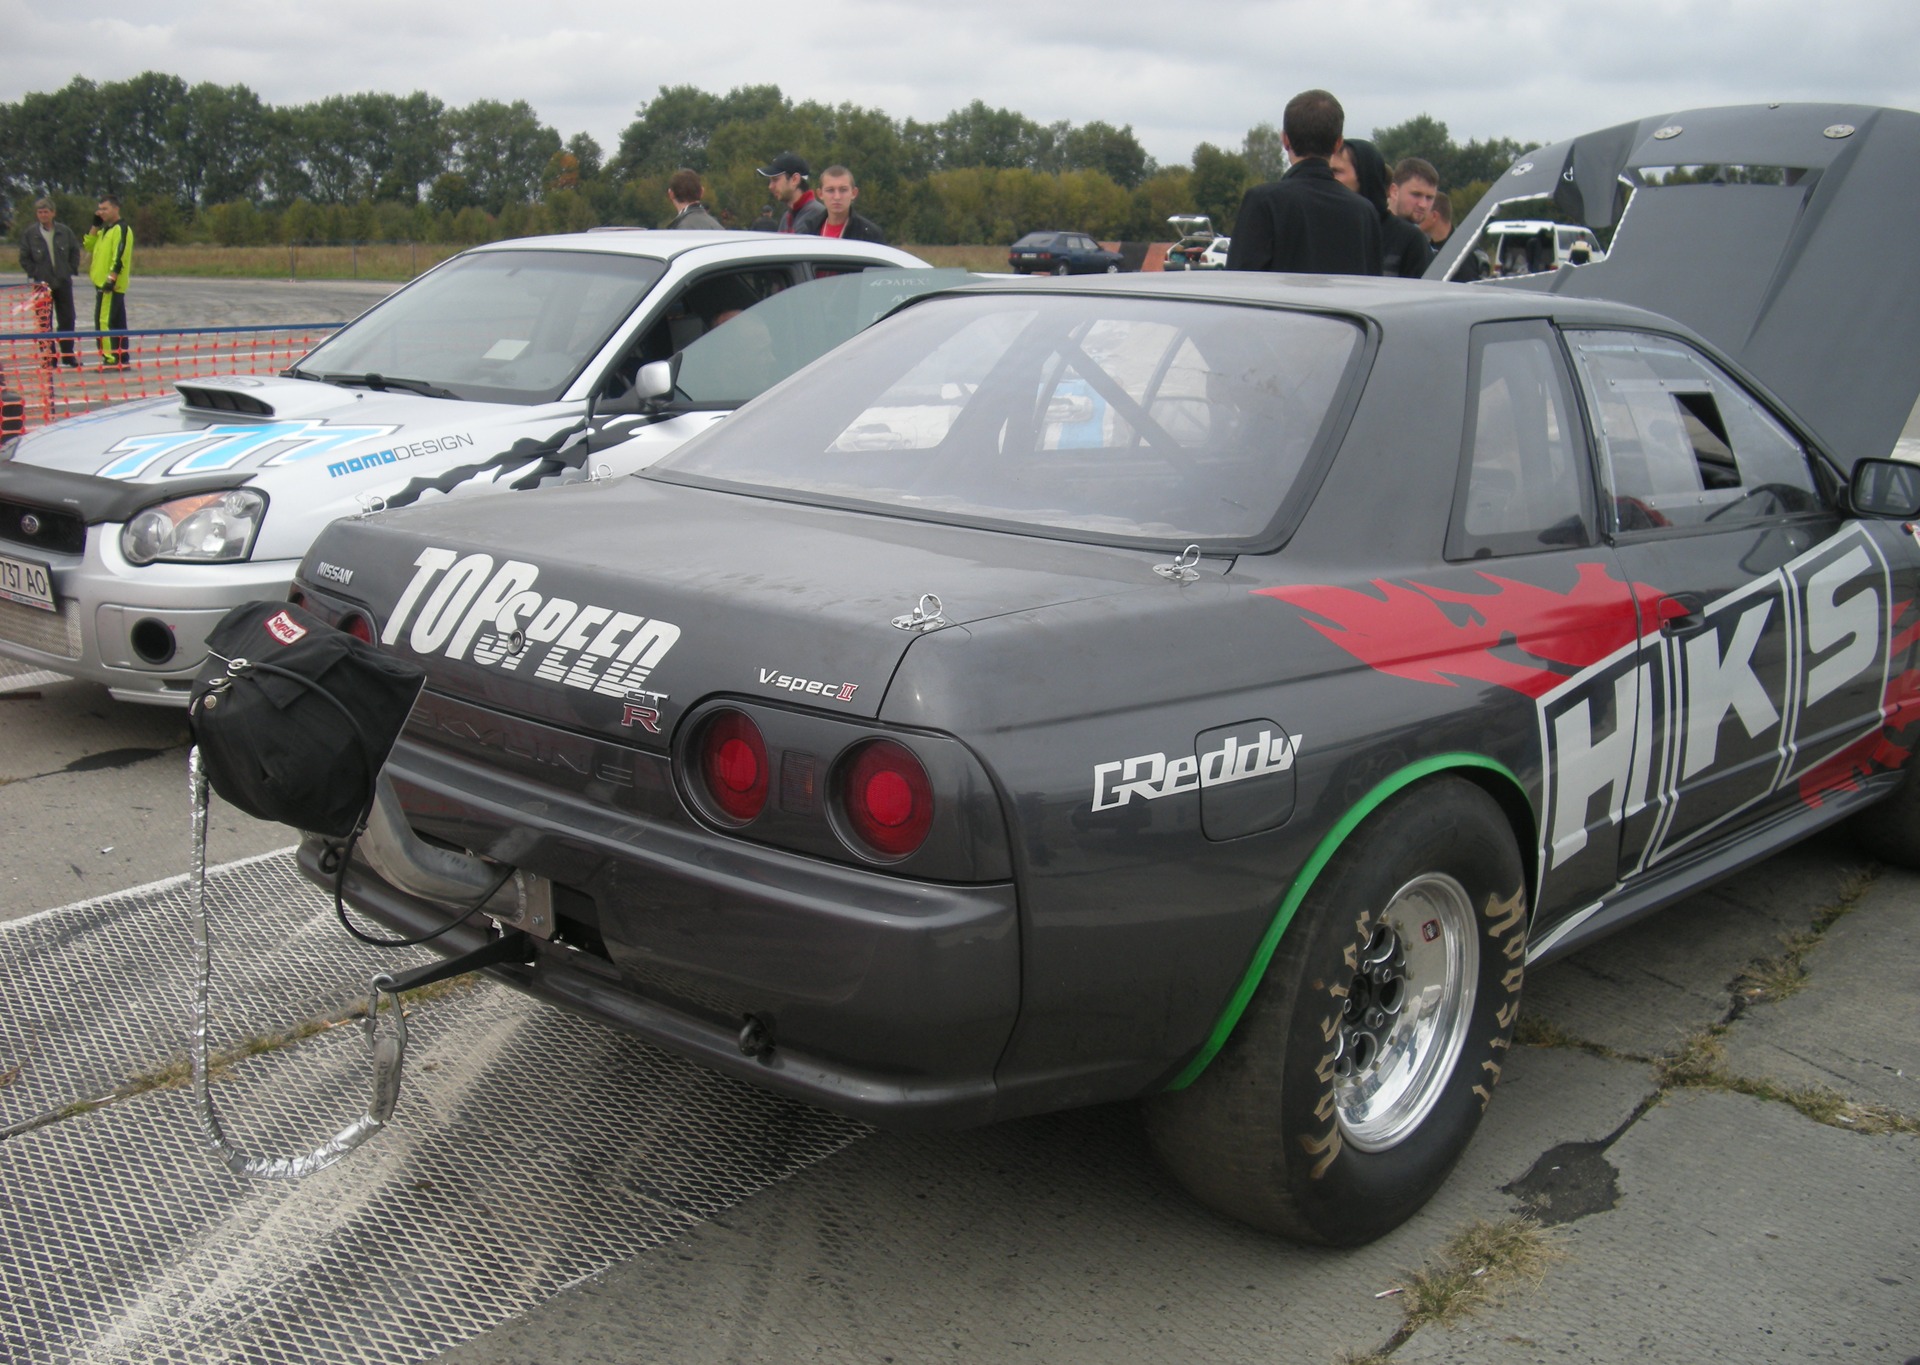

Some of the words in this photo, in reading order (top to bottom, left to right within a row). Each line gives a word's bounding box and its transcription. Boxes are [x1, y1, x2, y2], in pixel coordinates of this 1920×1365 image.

[94, 419, 404, 482] 777
[26, 567, 46, 596] AO
[317, 561, 354, 585] NISSAN
[381, 547, 540, 660] TOP
[473, 591, 681, 698] SPEED
[1551, 545, 1879, 870] HKS
